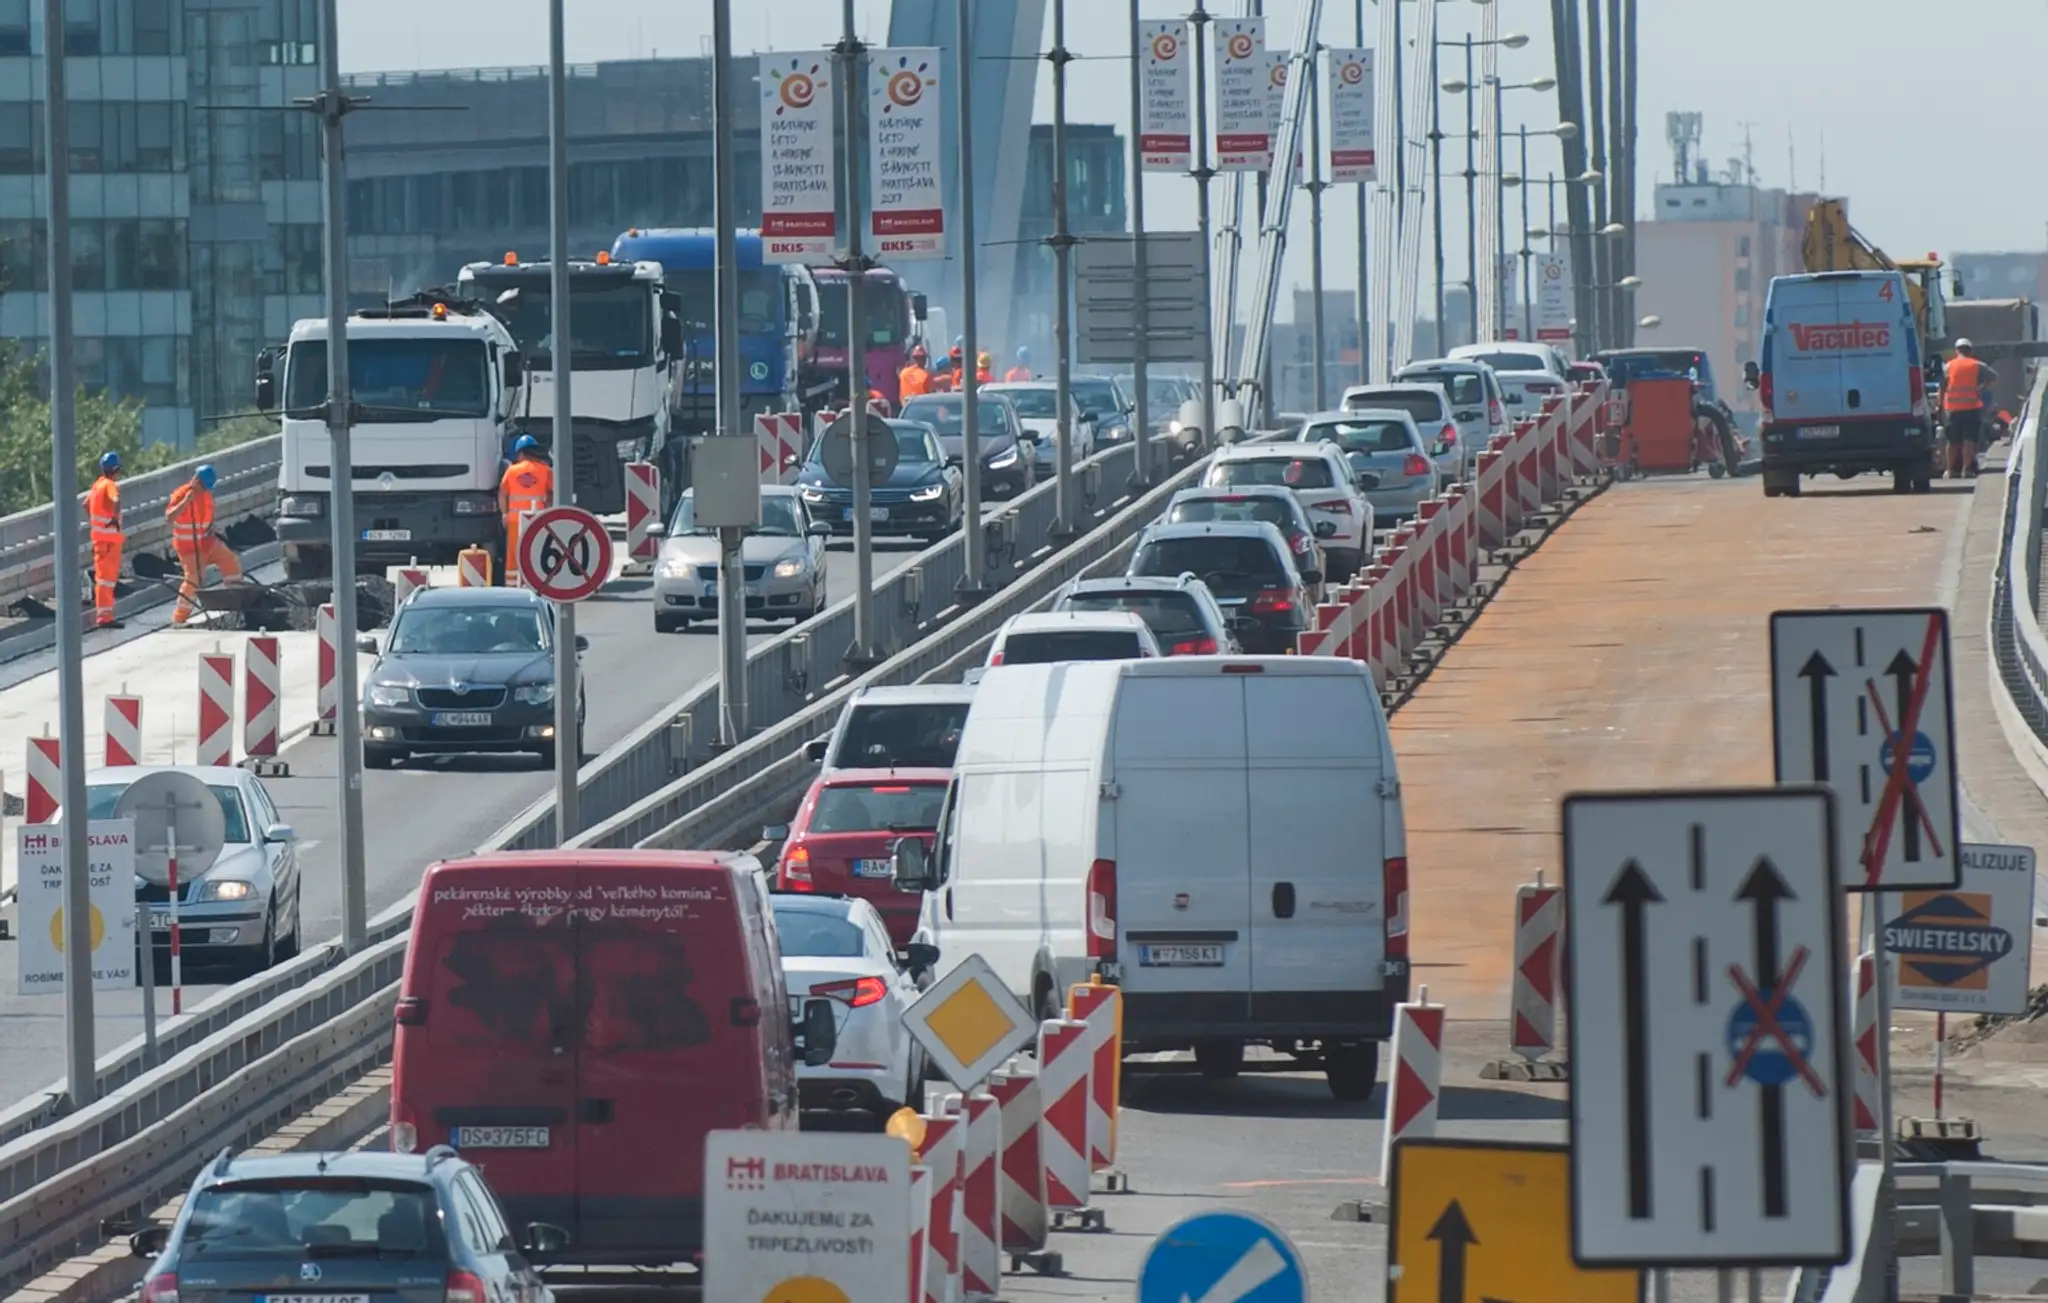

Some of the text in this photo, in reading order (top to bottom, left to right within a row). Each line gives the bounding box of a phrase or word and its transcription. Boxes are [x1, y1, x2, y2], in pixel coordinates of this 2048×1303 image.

[771, 243, 804, 253] BKIS
[881, 240, 914, 251] BKIS
[1879, 280, 1893, 301] 4
[541, 532, 589, 577] 60
[51, 834, 128, 848] BSLAVA
[1962, 852, 2028, 871] ALIZUJE
[514, 886, 571, 903] výrobky
[1884, 928, 2008, 953] SWIETELSKY
[773, 1163, 889, 1183] BRATISLAVA
[850, 1211, 874, 1228] ZA
